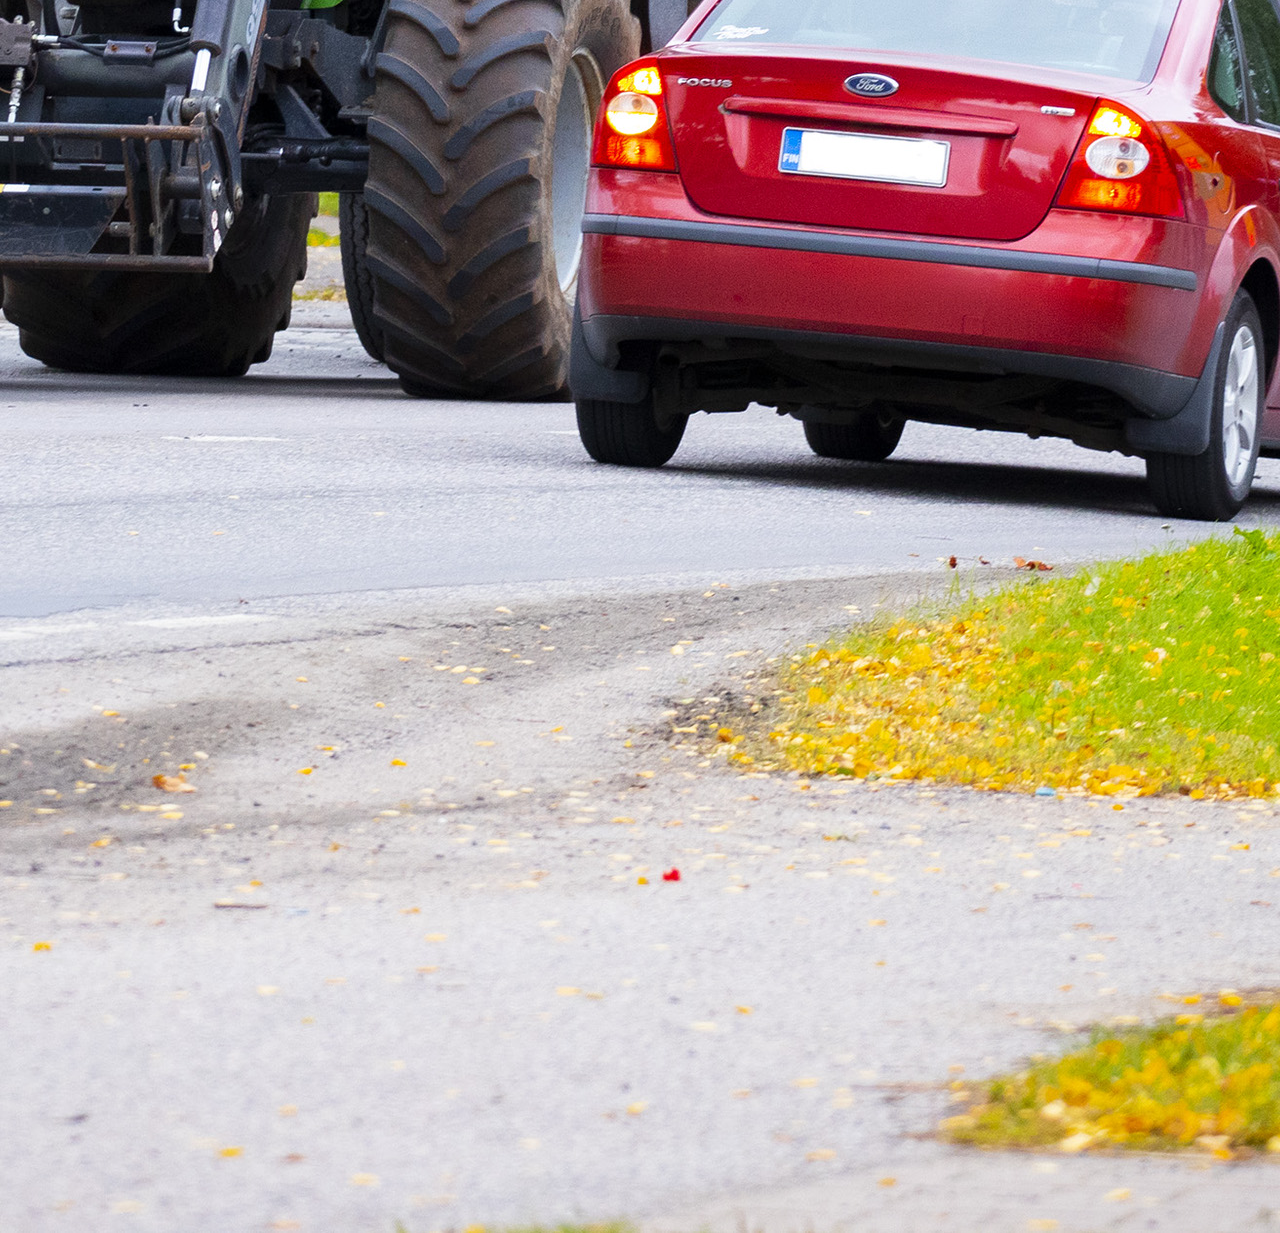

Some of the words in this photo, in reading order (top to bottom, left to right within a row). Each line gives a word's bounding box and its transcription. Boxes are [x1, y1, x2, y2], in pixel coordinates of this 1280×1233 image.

[677, 77, 733, 88] FOCUS
[855, 77, 887, 93] Ford
[782, 153, 799, 164] FIN
